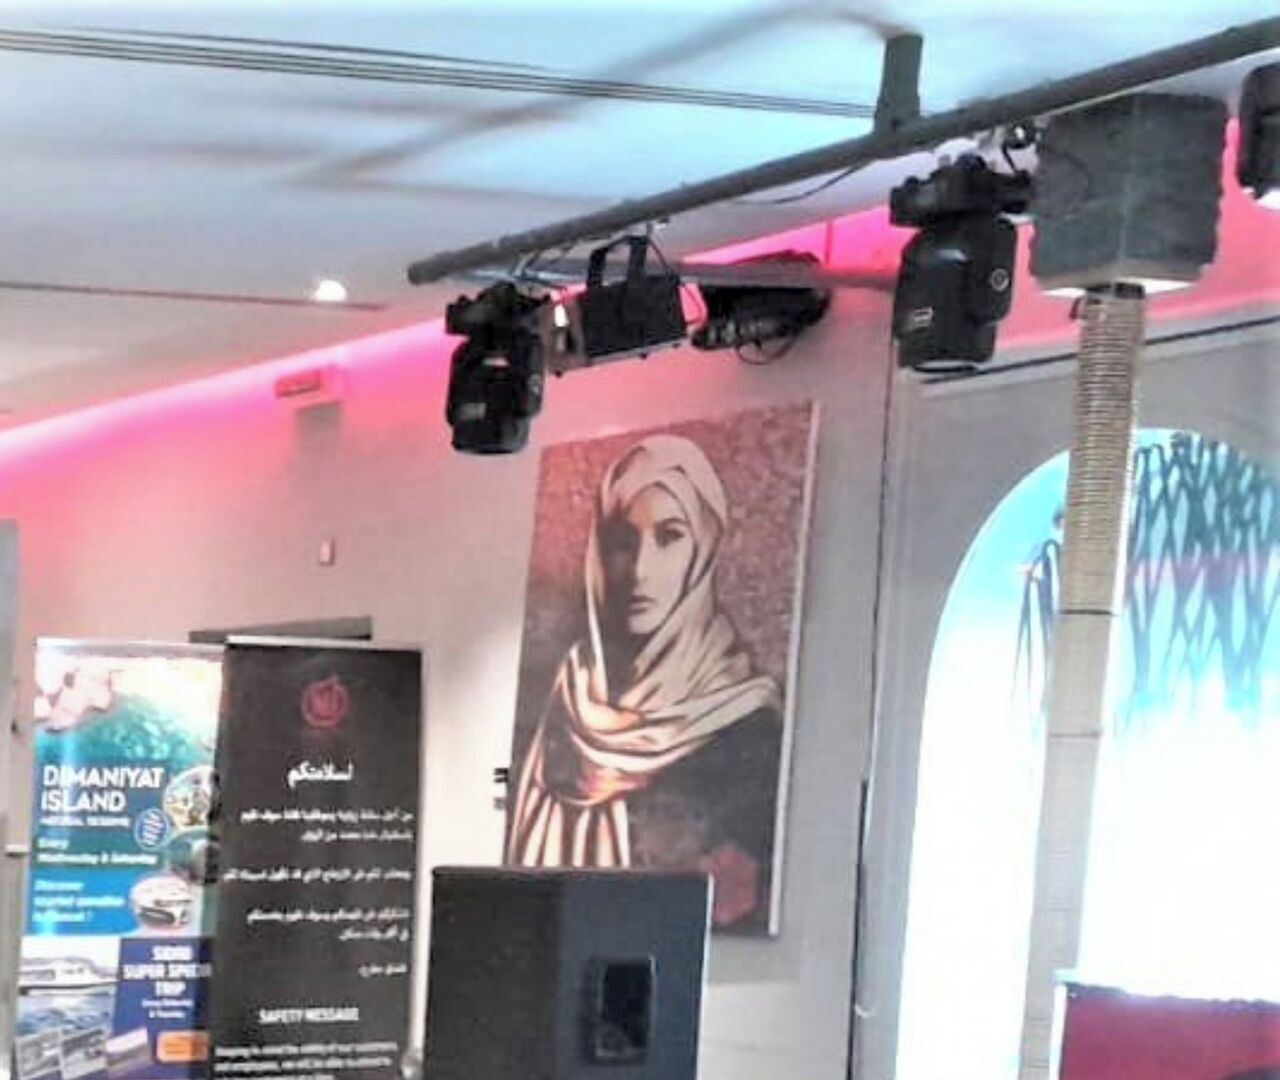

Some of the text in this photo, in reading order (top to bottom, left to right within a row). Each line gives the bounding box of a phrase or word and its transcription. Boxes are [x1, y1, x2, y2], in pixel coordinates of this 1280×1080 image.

[42, 765, 166, 788] DIMANIYAT
[40, 789, 126, 812] ISLAND
[258, 1007, 360, 1024] SAFETY MESSAGE
